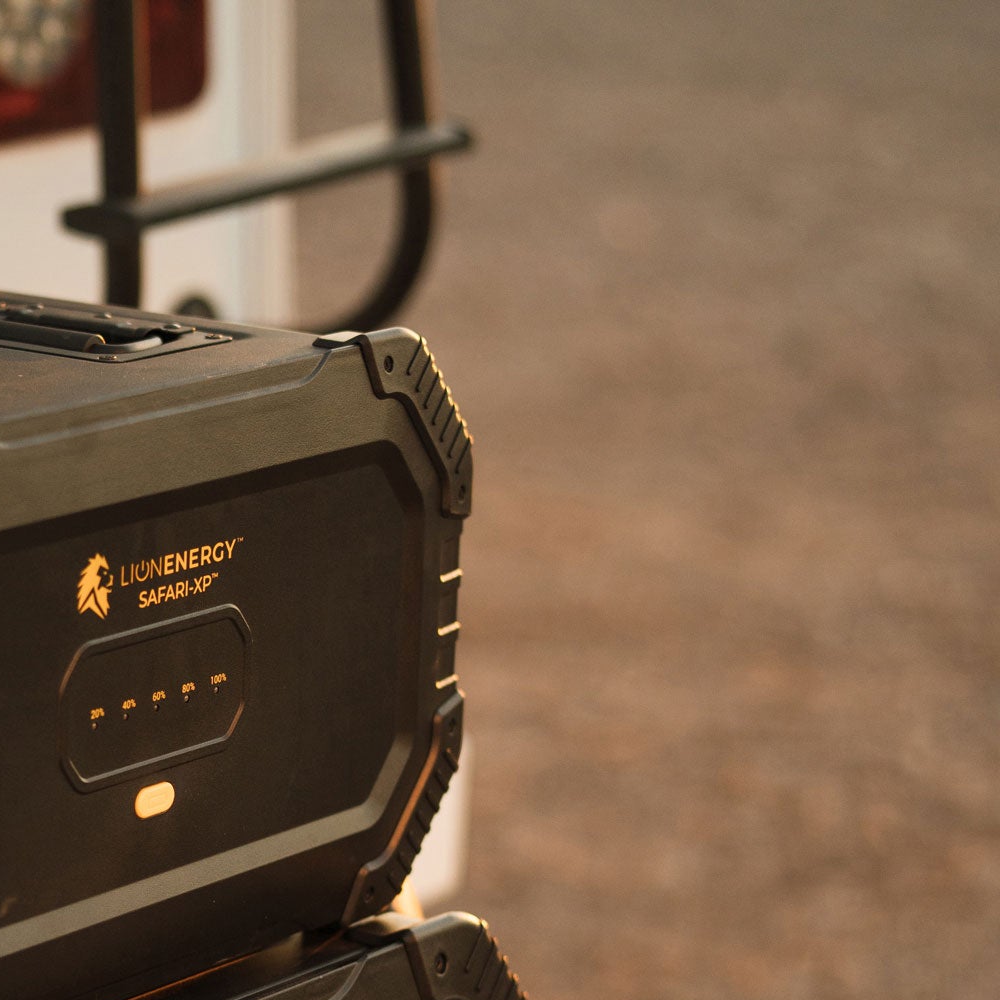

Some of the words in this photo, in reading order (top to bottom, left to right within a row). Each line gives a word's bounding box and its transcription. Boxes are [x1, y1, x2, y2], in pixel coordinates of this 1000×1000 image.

[90, 707, 105, 720] 20%
[121, 698, 137, 710] 40%
[152, 690, 167, 702] 60%
[181, 682, 196, 694] 80%
[210, 673, 227, 685] 100%
